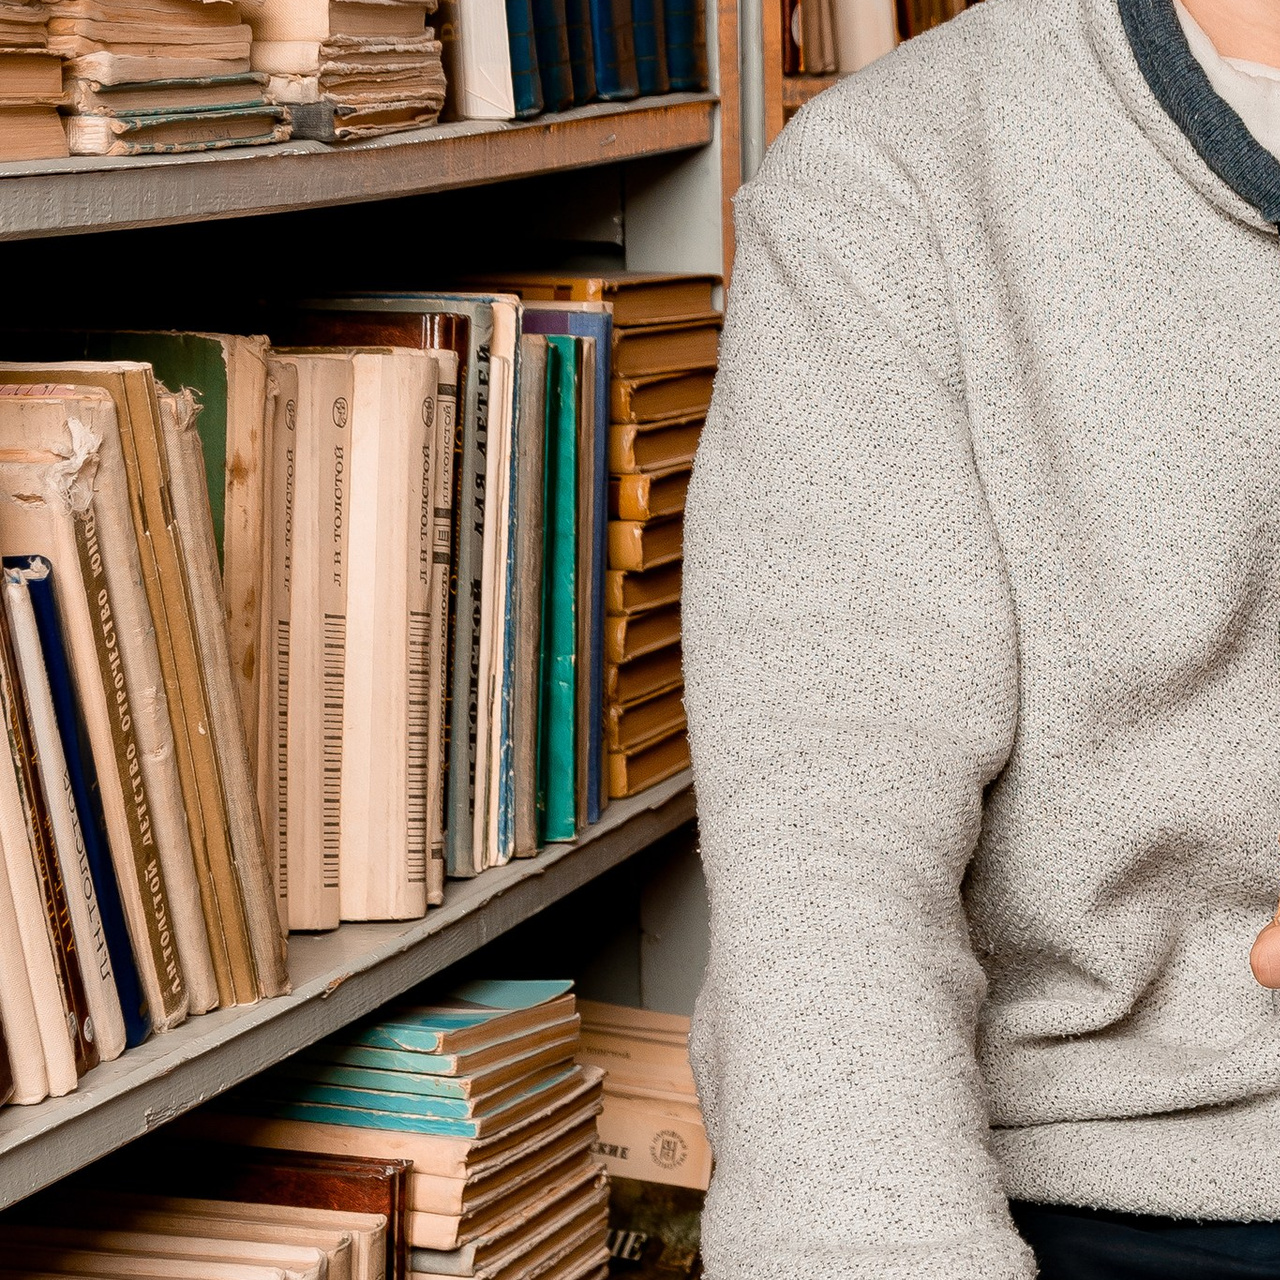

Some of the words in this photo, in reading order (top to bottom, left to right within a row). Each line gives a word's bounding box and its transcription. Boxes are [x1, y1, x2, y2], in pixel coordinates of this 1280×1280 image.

[284, 448, 295, 553] ТОЛСТОЙ
[333, 445, 345, 543] ТОЛСТОЙ
[419, 444, 431, 544] ТОЛСТОЙ
[333, 550, 343, 565] Н
[419, 547, 430, 562] Н
[97, 589, 132, 734] ОТРОЧЕСТВО
[126, 742, 154, 846] ДЕТСТВО
